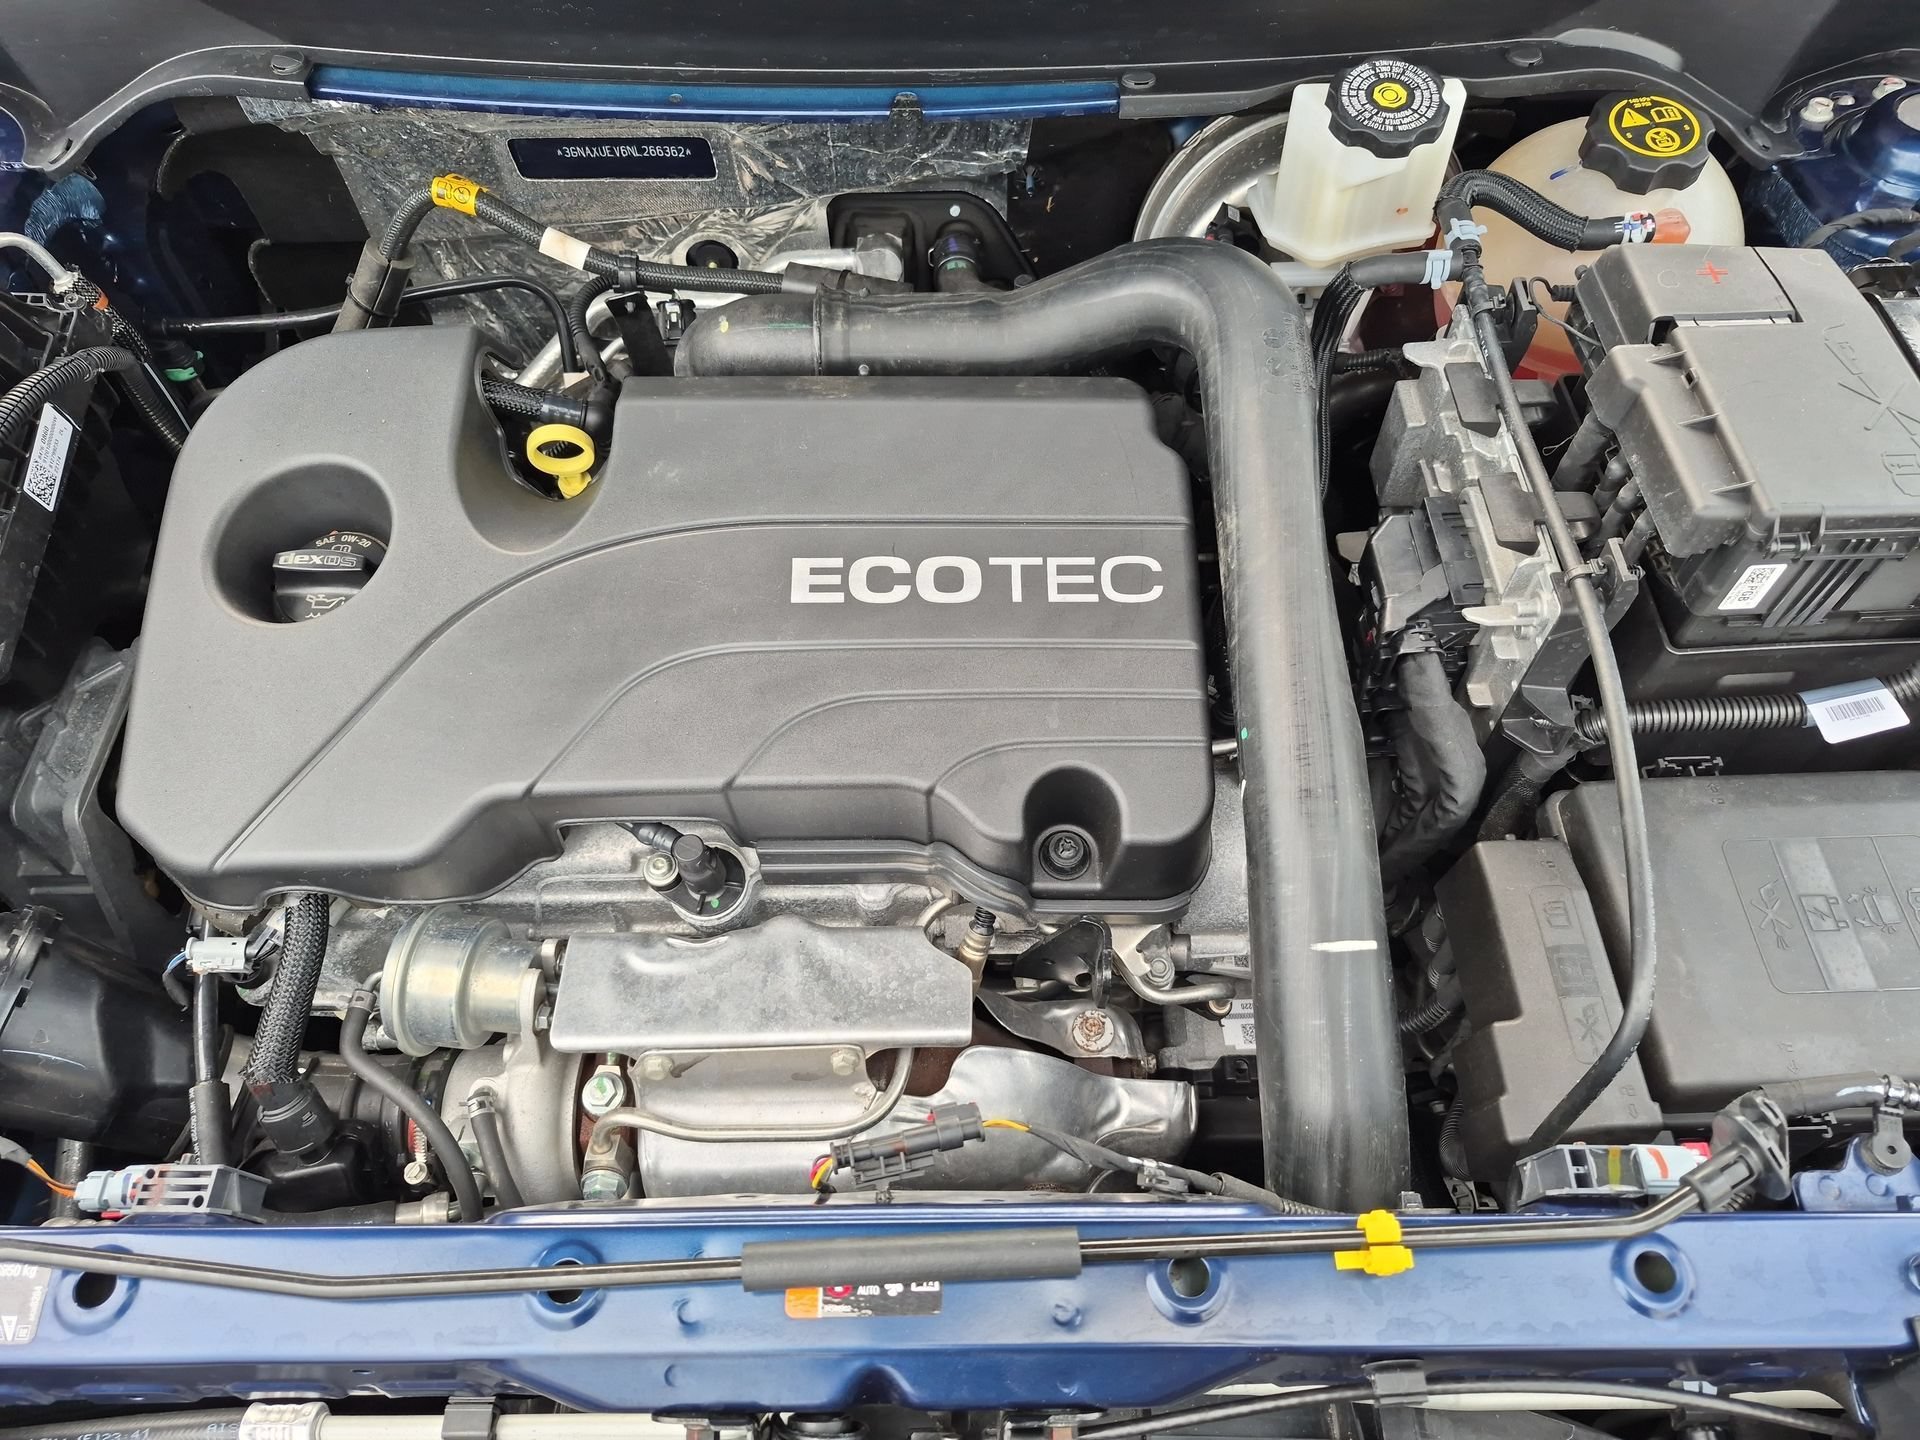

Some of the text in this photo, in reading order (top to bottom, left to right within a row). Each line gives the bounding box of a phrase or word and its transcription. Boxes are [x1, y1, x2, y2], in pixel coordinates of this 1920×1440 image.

[1392, 65, 1403, 73] USE
[1407, 63, 1429, 80] SEALED
[1400, 76, 1418, 89] CLEAN
[1363, 119, 1394, 132] NETTOYER
[315, 534, 372, 548] SAE 0W-20
[790, 555, 1164, 604] ECOTEC
[22, 1263, 38, 1279] kg
[857, 1284, 880, 1296] AUTO
